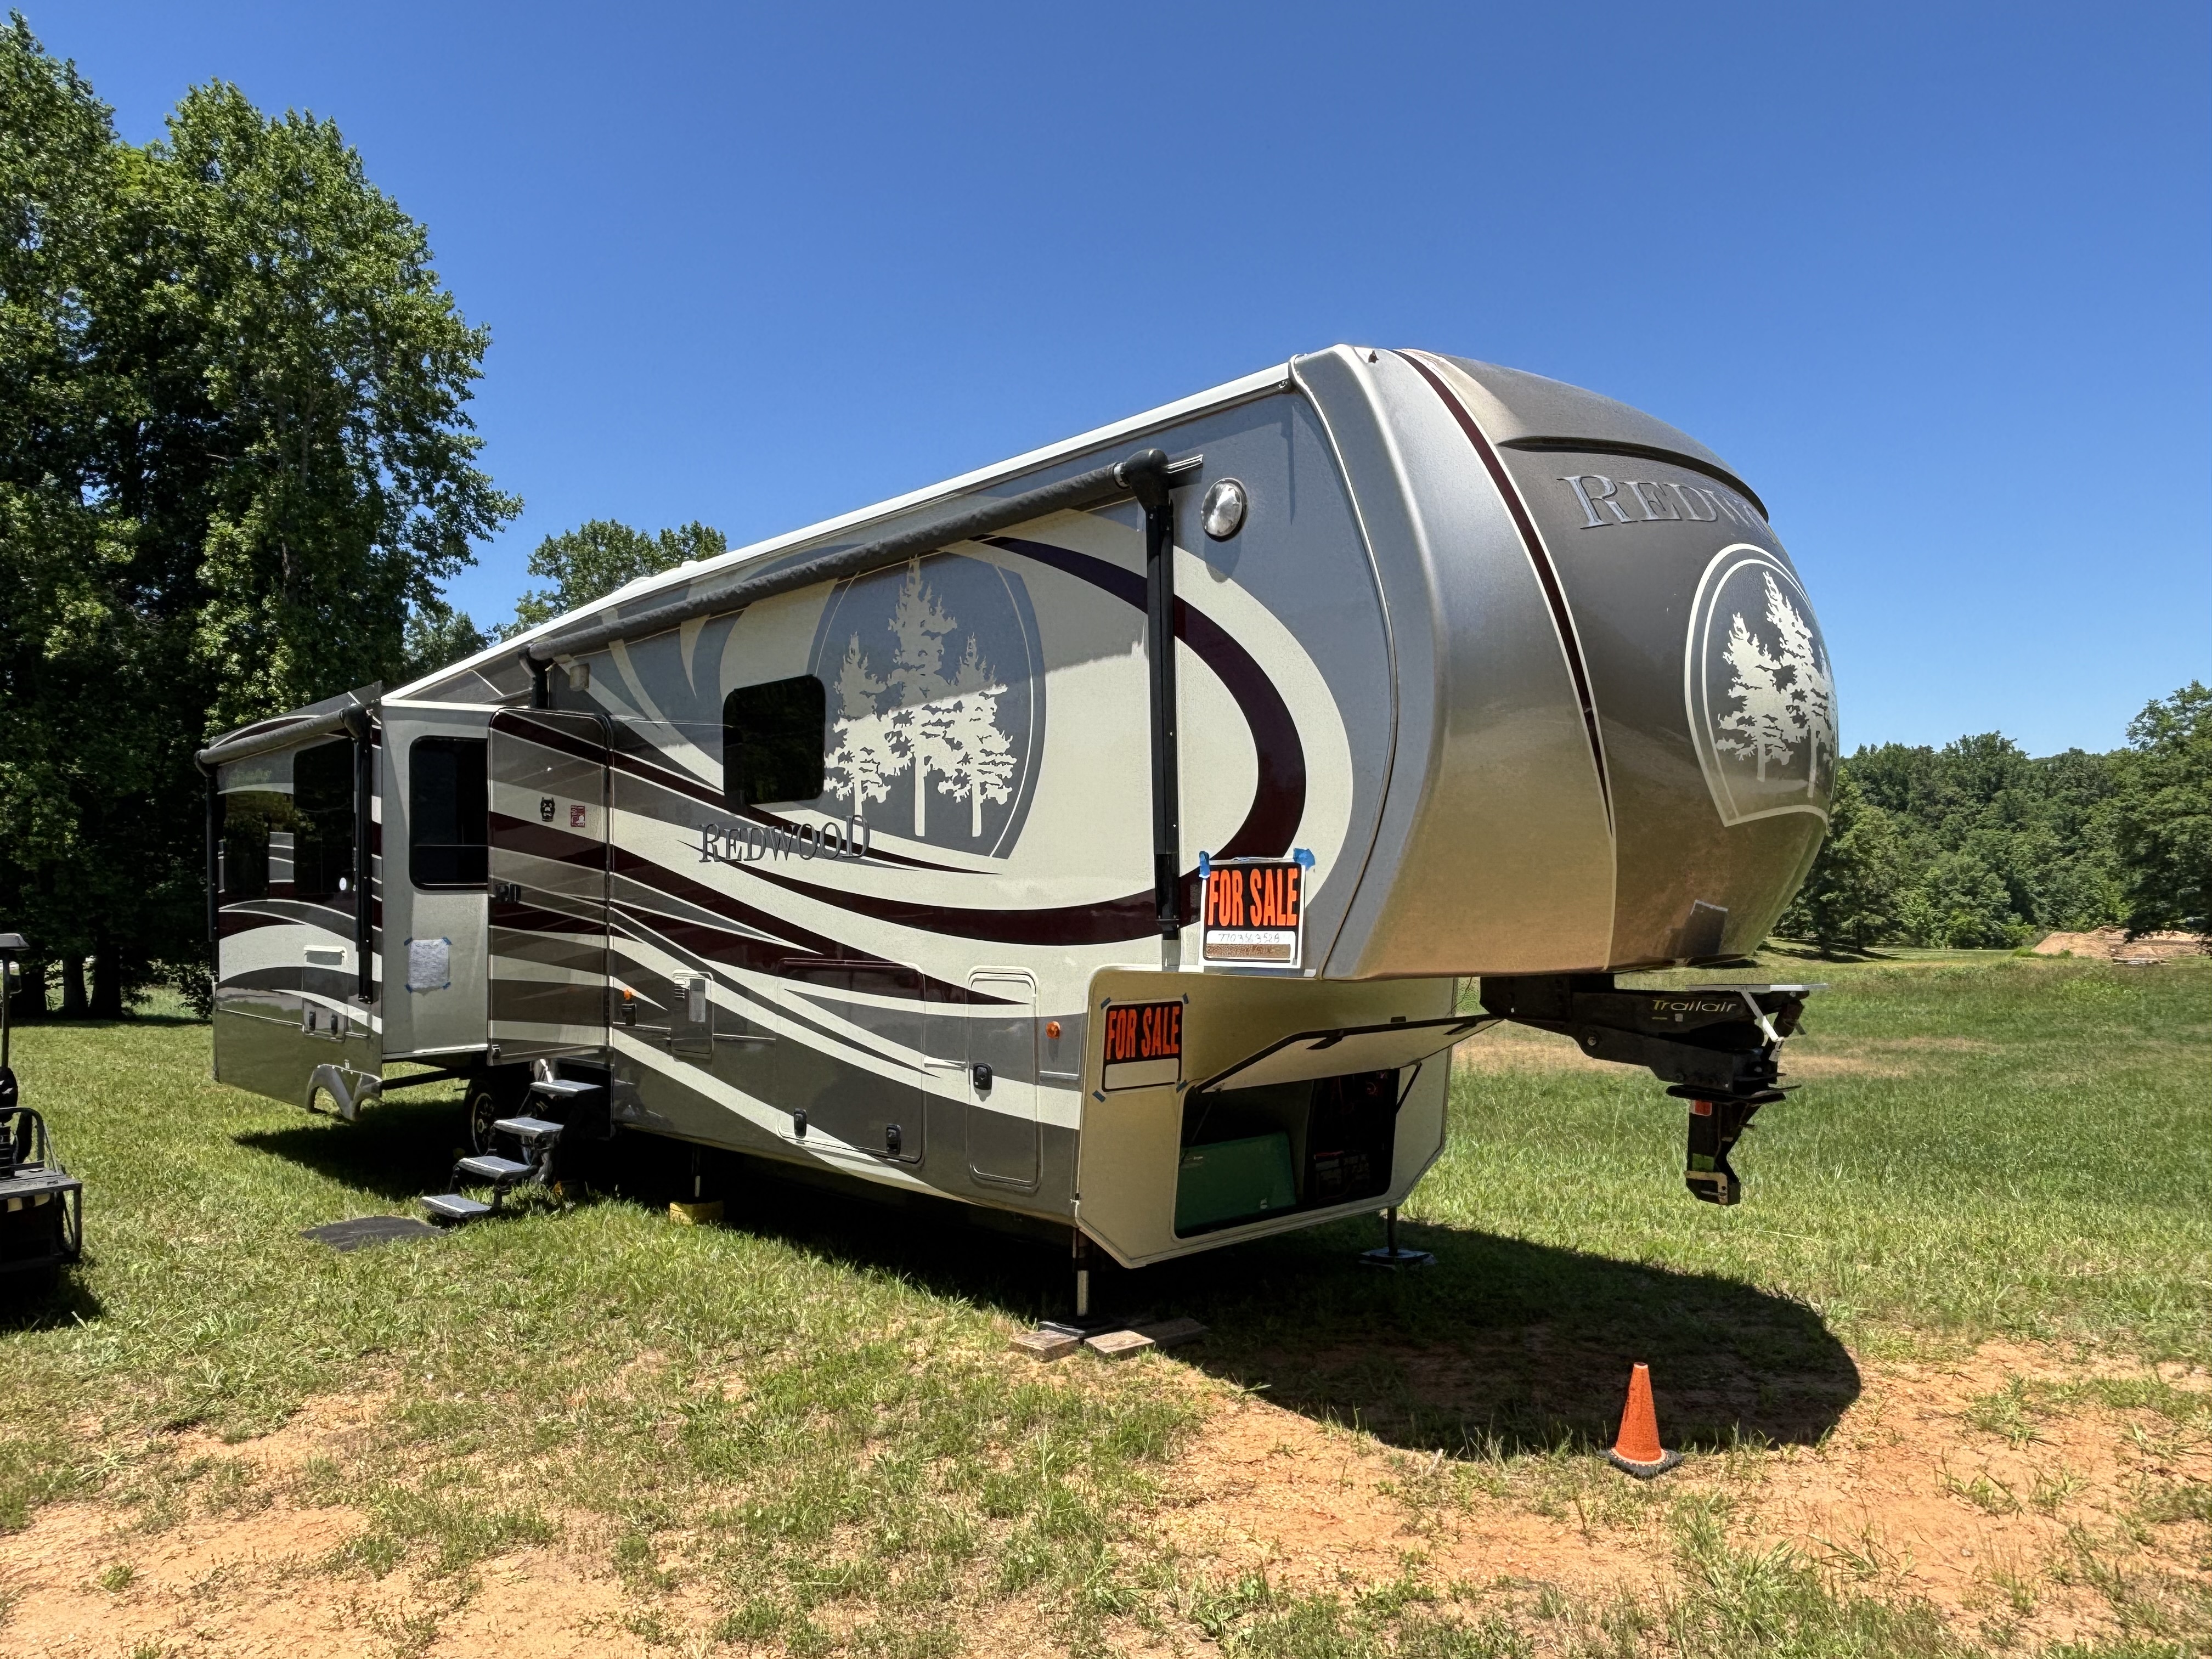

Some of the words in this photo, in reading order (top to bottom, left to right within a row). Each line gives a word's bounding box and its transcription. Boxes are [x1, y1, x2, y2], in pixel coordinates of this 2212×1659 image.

[699, 814, 870, 863] REDWOOD
[1208, 869, 1243, 927] FOR
[1250, 868, 1298, 927] SALE
[1652, 1000, 1737, 1012] Trailair
[1106, 1008, 1137, 1060] FOR
[1141, 1006, 1180, 1057] SALE
